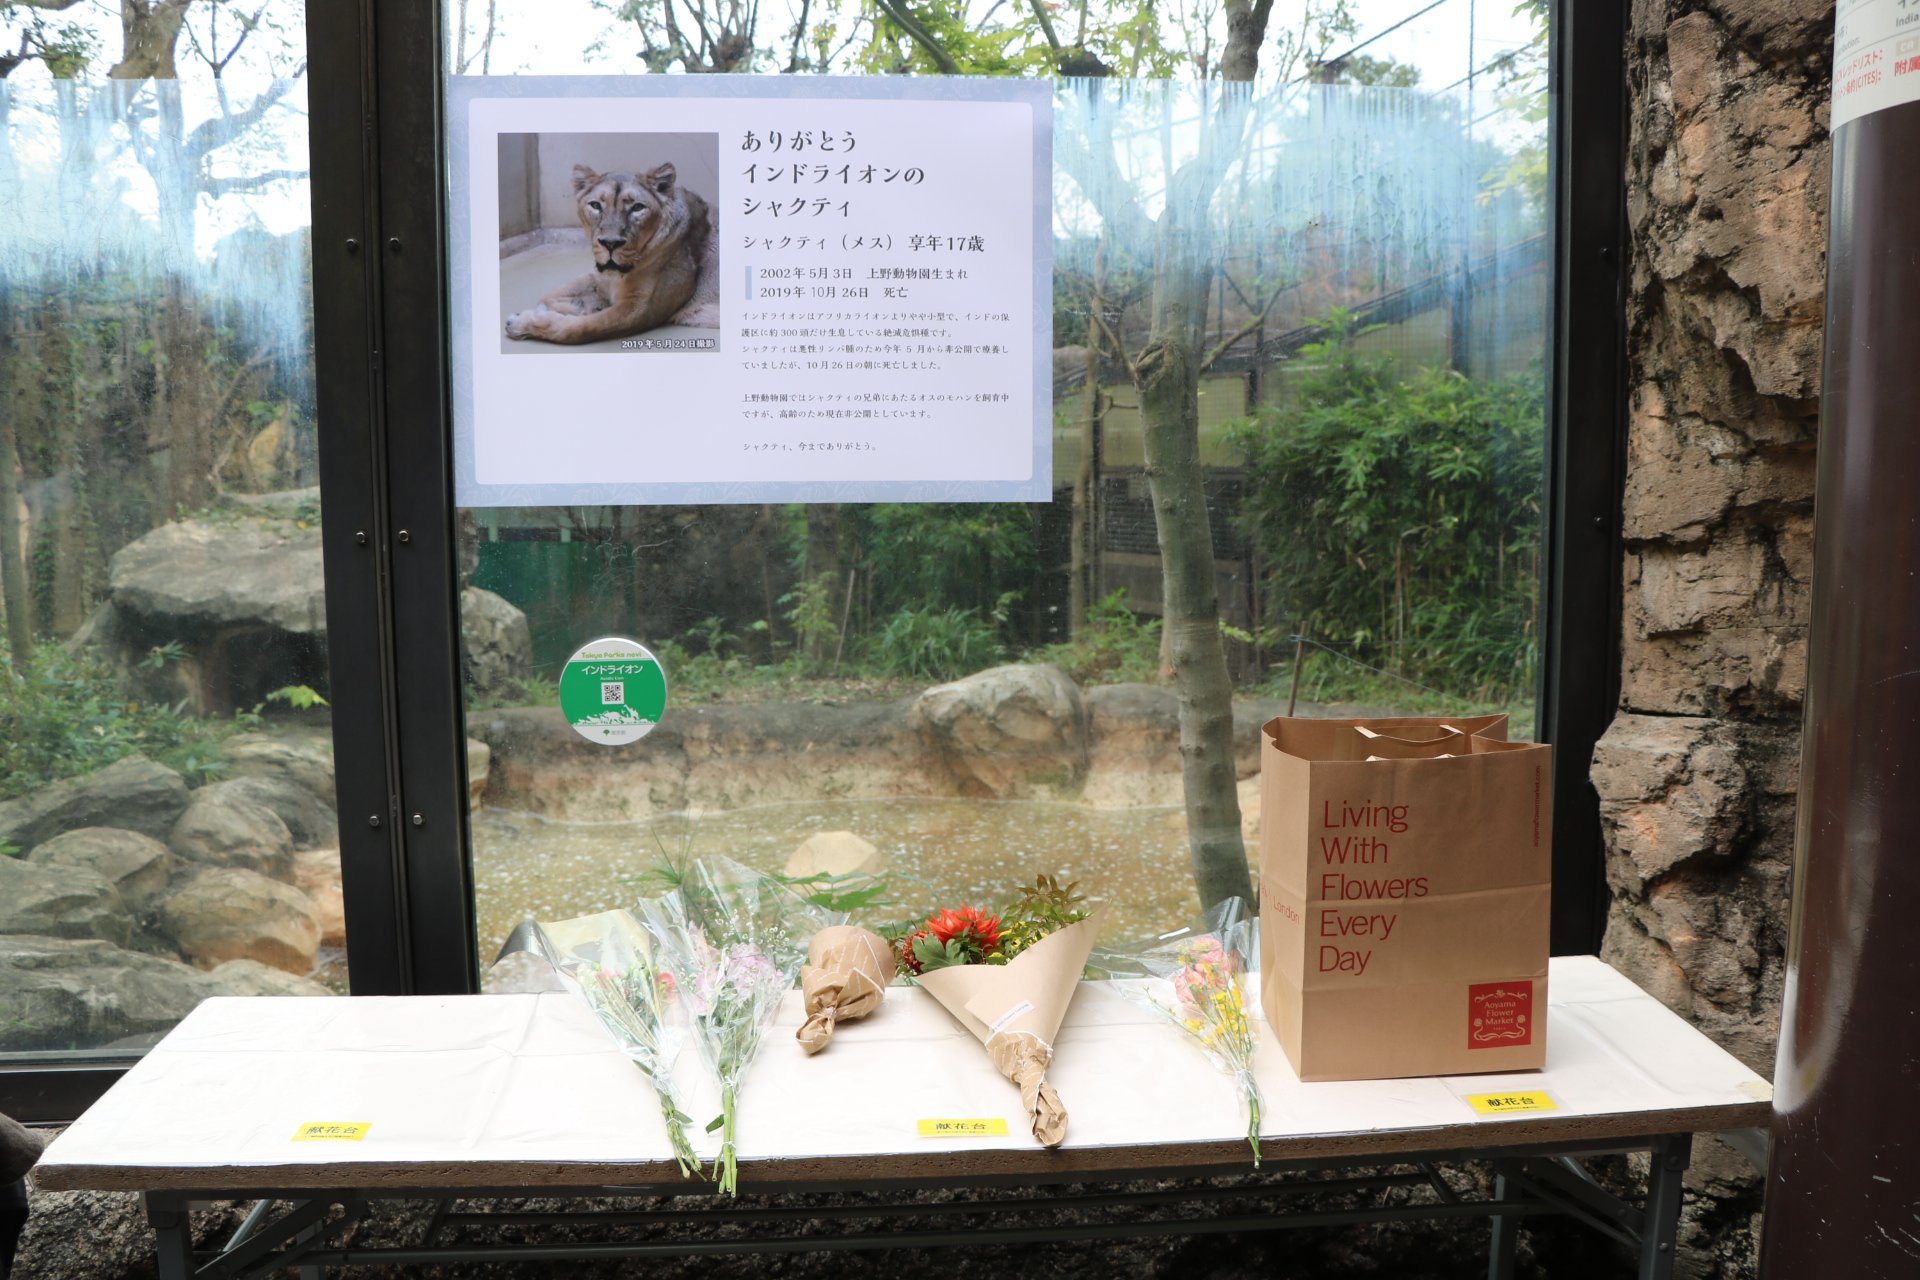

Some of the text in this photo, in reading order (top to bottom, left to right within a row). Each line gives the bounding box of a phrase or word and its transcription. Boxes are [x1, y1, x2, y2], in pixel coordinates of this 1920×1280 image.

[741, 129, 856, 153] ありがとう
[741, 163, 925, 185] インドライオンの
[743, 197, 850, 218] シャクティ
[908, 233, 985, 253] 享年17歳
[866, 266, 969, 280] 上野動物園生まれ
[884, 286, 909, 299] 死亡
[581, 664, 644, 675] インドライオン
[1323, 799, 1410, 834] Living
[1320, 836, 1389, 865] With
[1321, 873, 1429, 901] Flowers
[1273, 895, 1300, 926] London
[1320, 909, 1397, 941] Every
[1318, 945, 1372, 977] Day
[1484, 1001, 1516, 1009] Aoyama
[1486, 1010, 1513, 1018] Flower
[1486, 1096, 1535, 1107] 献花台
